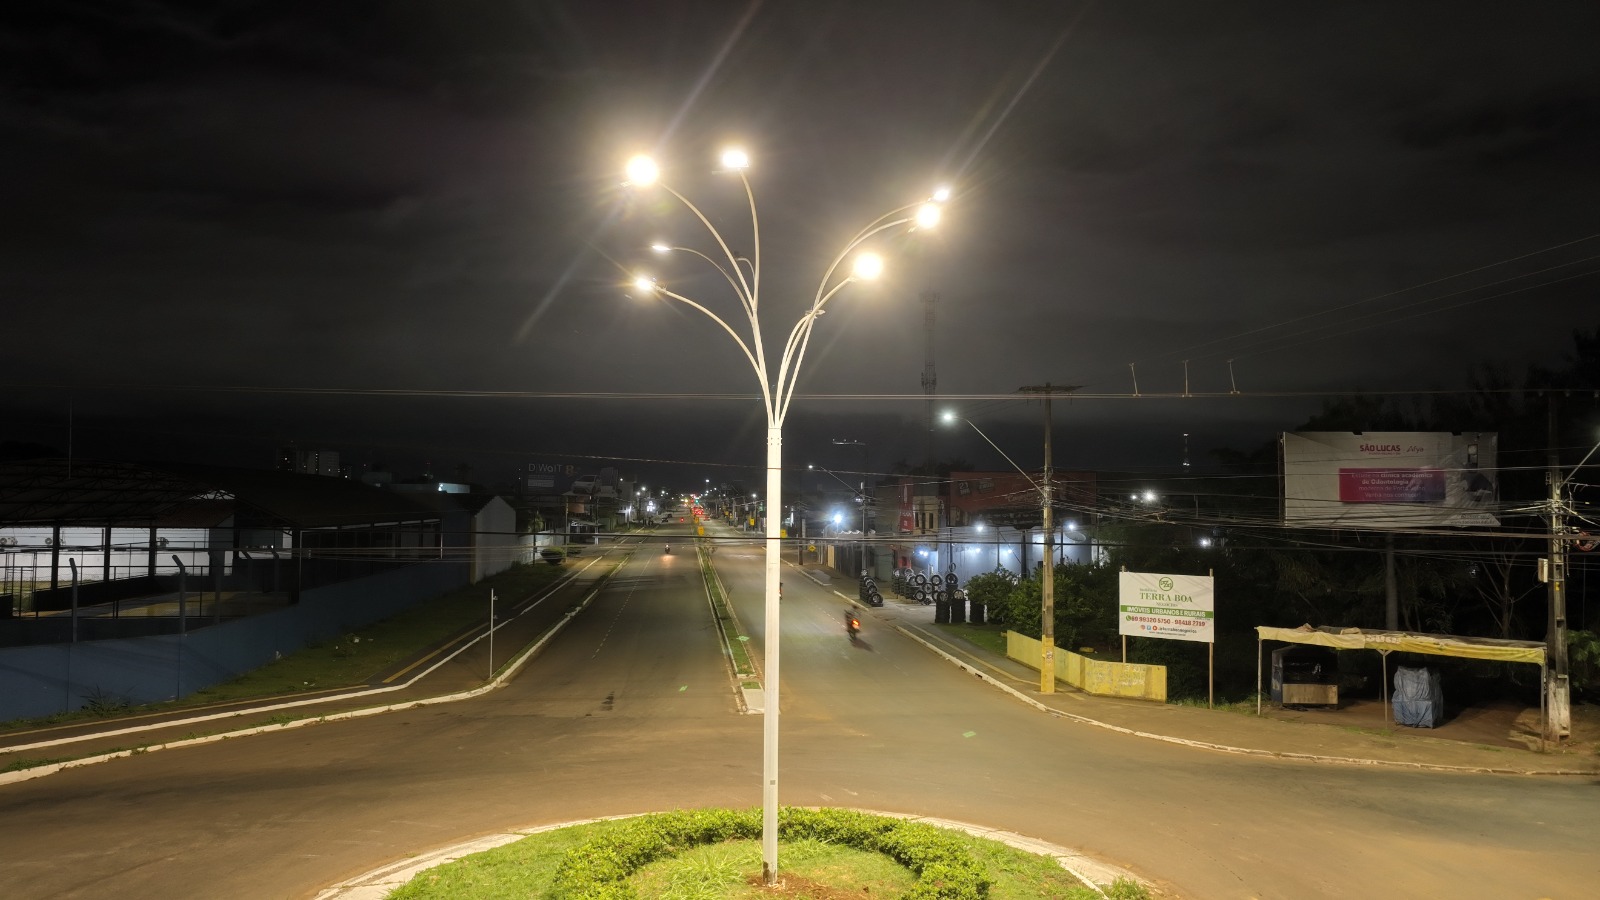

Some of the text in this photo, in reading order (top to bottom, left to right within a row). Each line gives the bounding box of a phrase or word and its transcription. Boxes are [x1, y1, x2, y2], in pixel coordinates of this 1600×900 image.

[1360, 444, 1375, 452] SÃO
[1140, 592, 1193, 602] TERRA BOA
